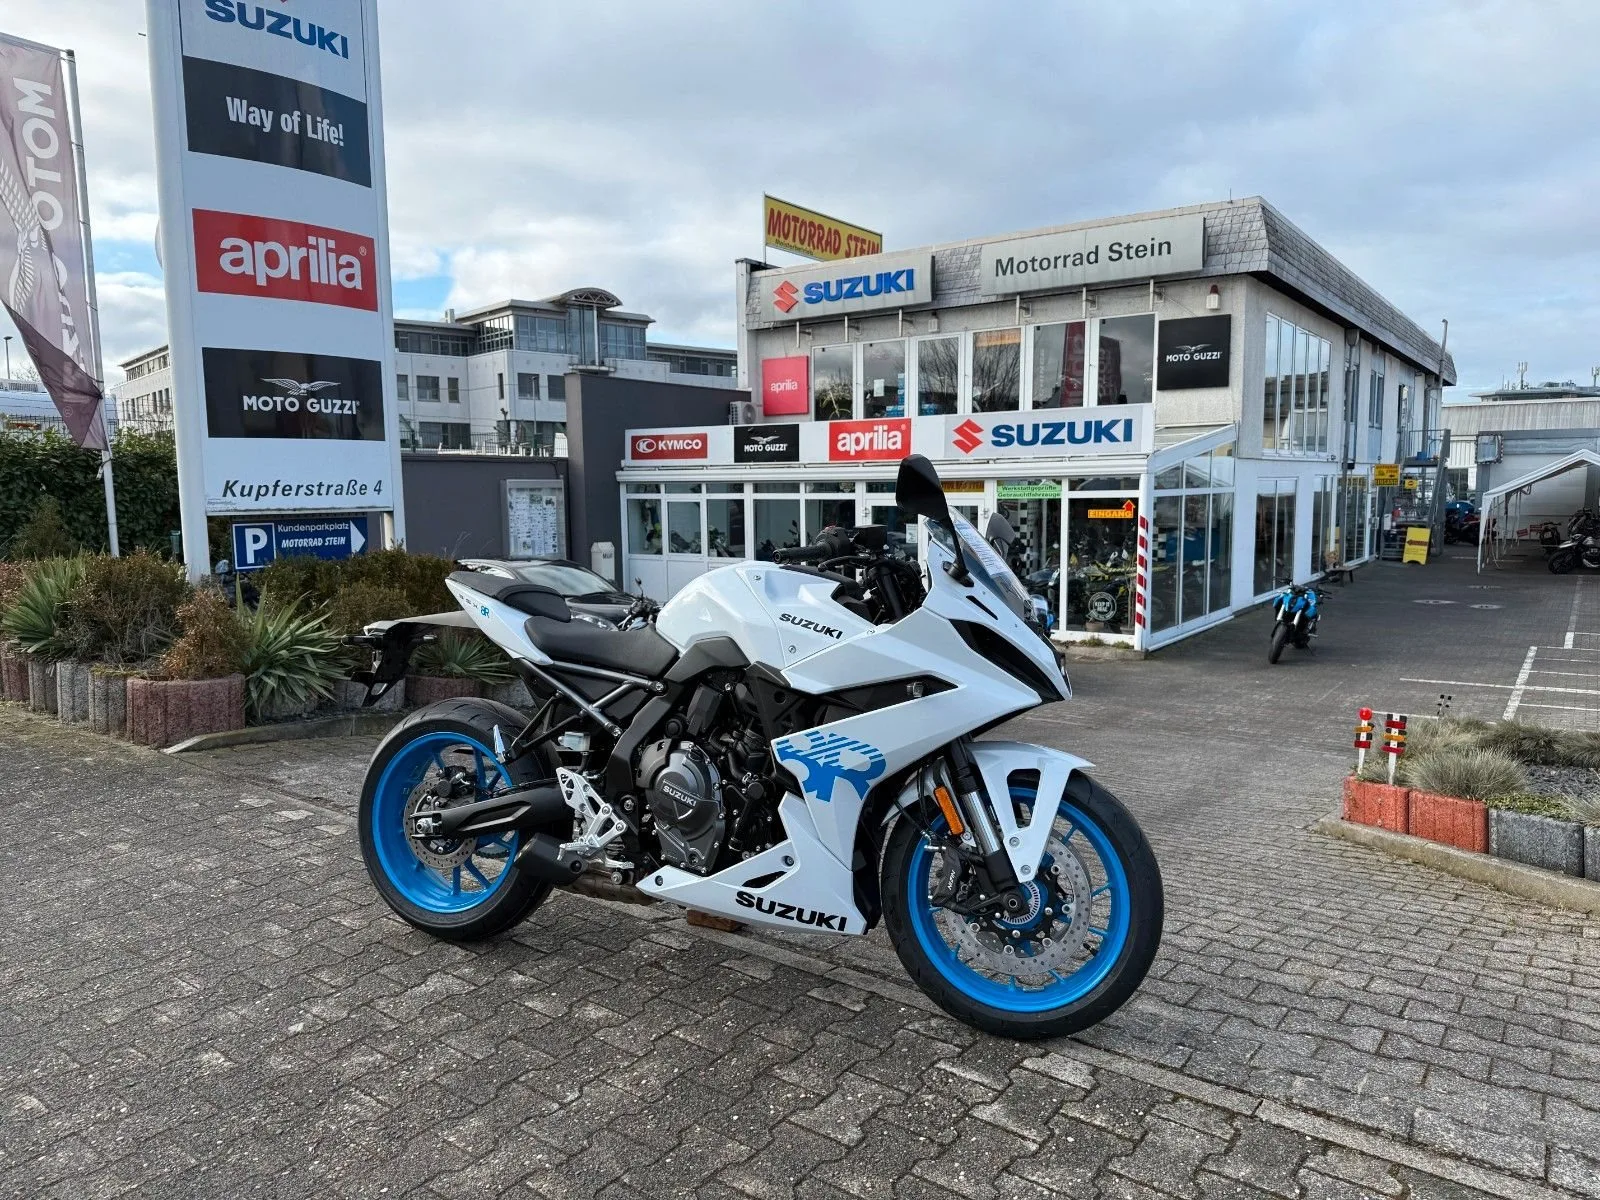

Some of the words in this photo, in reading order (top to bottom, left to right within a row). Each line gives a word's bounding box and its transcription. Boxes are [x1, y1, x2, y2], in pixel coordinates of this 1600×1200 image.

[205, 0, 348, 59] SUZUKI
[226, 96, 273, 132] Way
[281, 112, 301, 135] of
[306, 113, 344, 146] Life!
[767, 207, 842, 255] MOTORRAD
[844, 233, 880, 258] STEIN
[219, 236, 363, 290] aprilia
[995, 249, 1099, 277] Motorrad
[1108, 237, 1172, 262] Stein
[804, 268, 915, 304] SUZUKI
[1166, 353, 1191, 362] MOTO
[1193, 351, 1220, 361] GUZZI
[770, 378, 798, 394] aprilia
[243, 395, 299, 412] MOTO
[306, 397, 357, 415] GUZZI
[658, 439, 702, 451] KYMCO
[837, 425, 902, 455] aprilia
[991, 418, 1133, 447] SUZUKI
[744, 444, 763, 452] MOTO
[765, 443, 787, 452] GUZZI
[222, 479, 368, 501] Kupferstraße
[373, 480, 383, 495] 4
[277, 522, 349, 533] Kundenparkplatz
[244, 528, 268, 564] P
[281, 538, 323, 548] MOTORRAD
[324, 536, 346, 546] STEIN
[779, 613, 843, 639] SUZUKI
[663, 785, 697, 807] SUZUKI
[735, 890, 847, 932] SUZUKI
